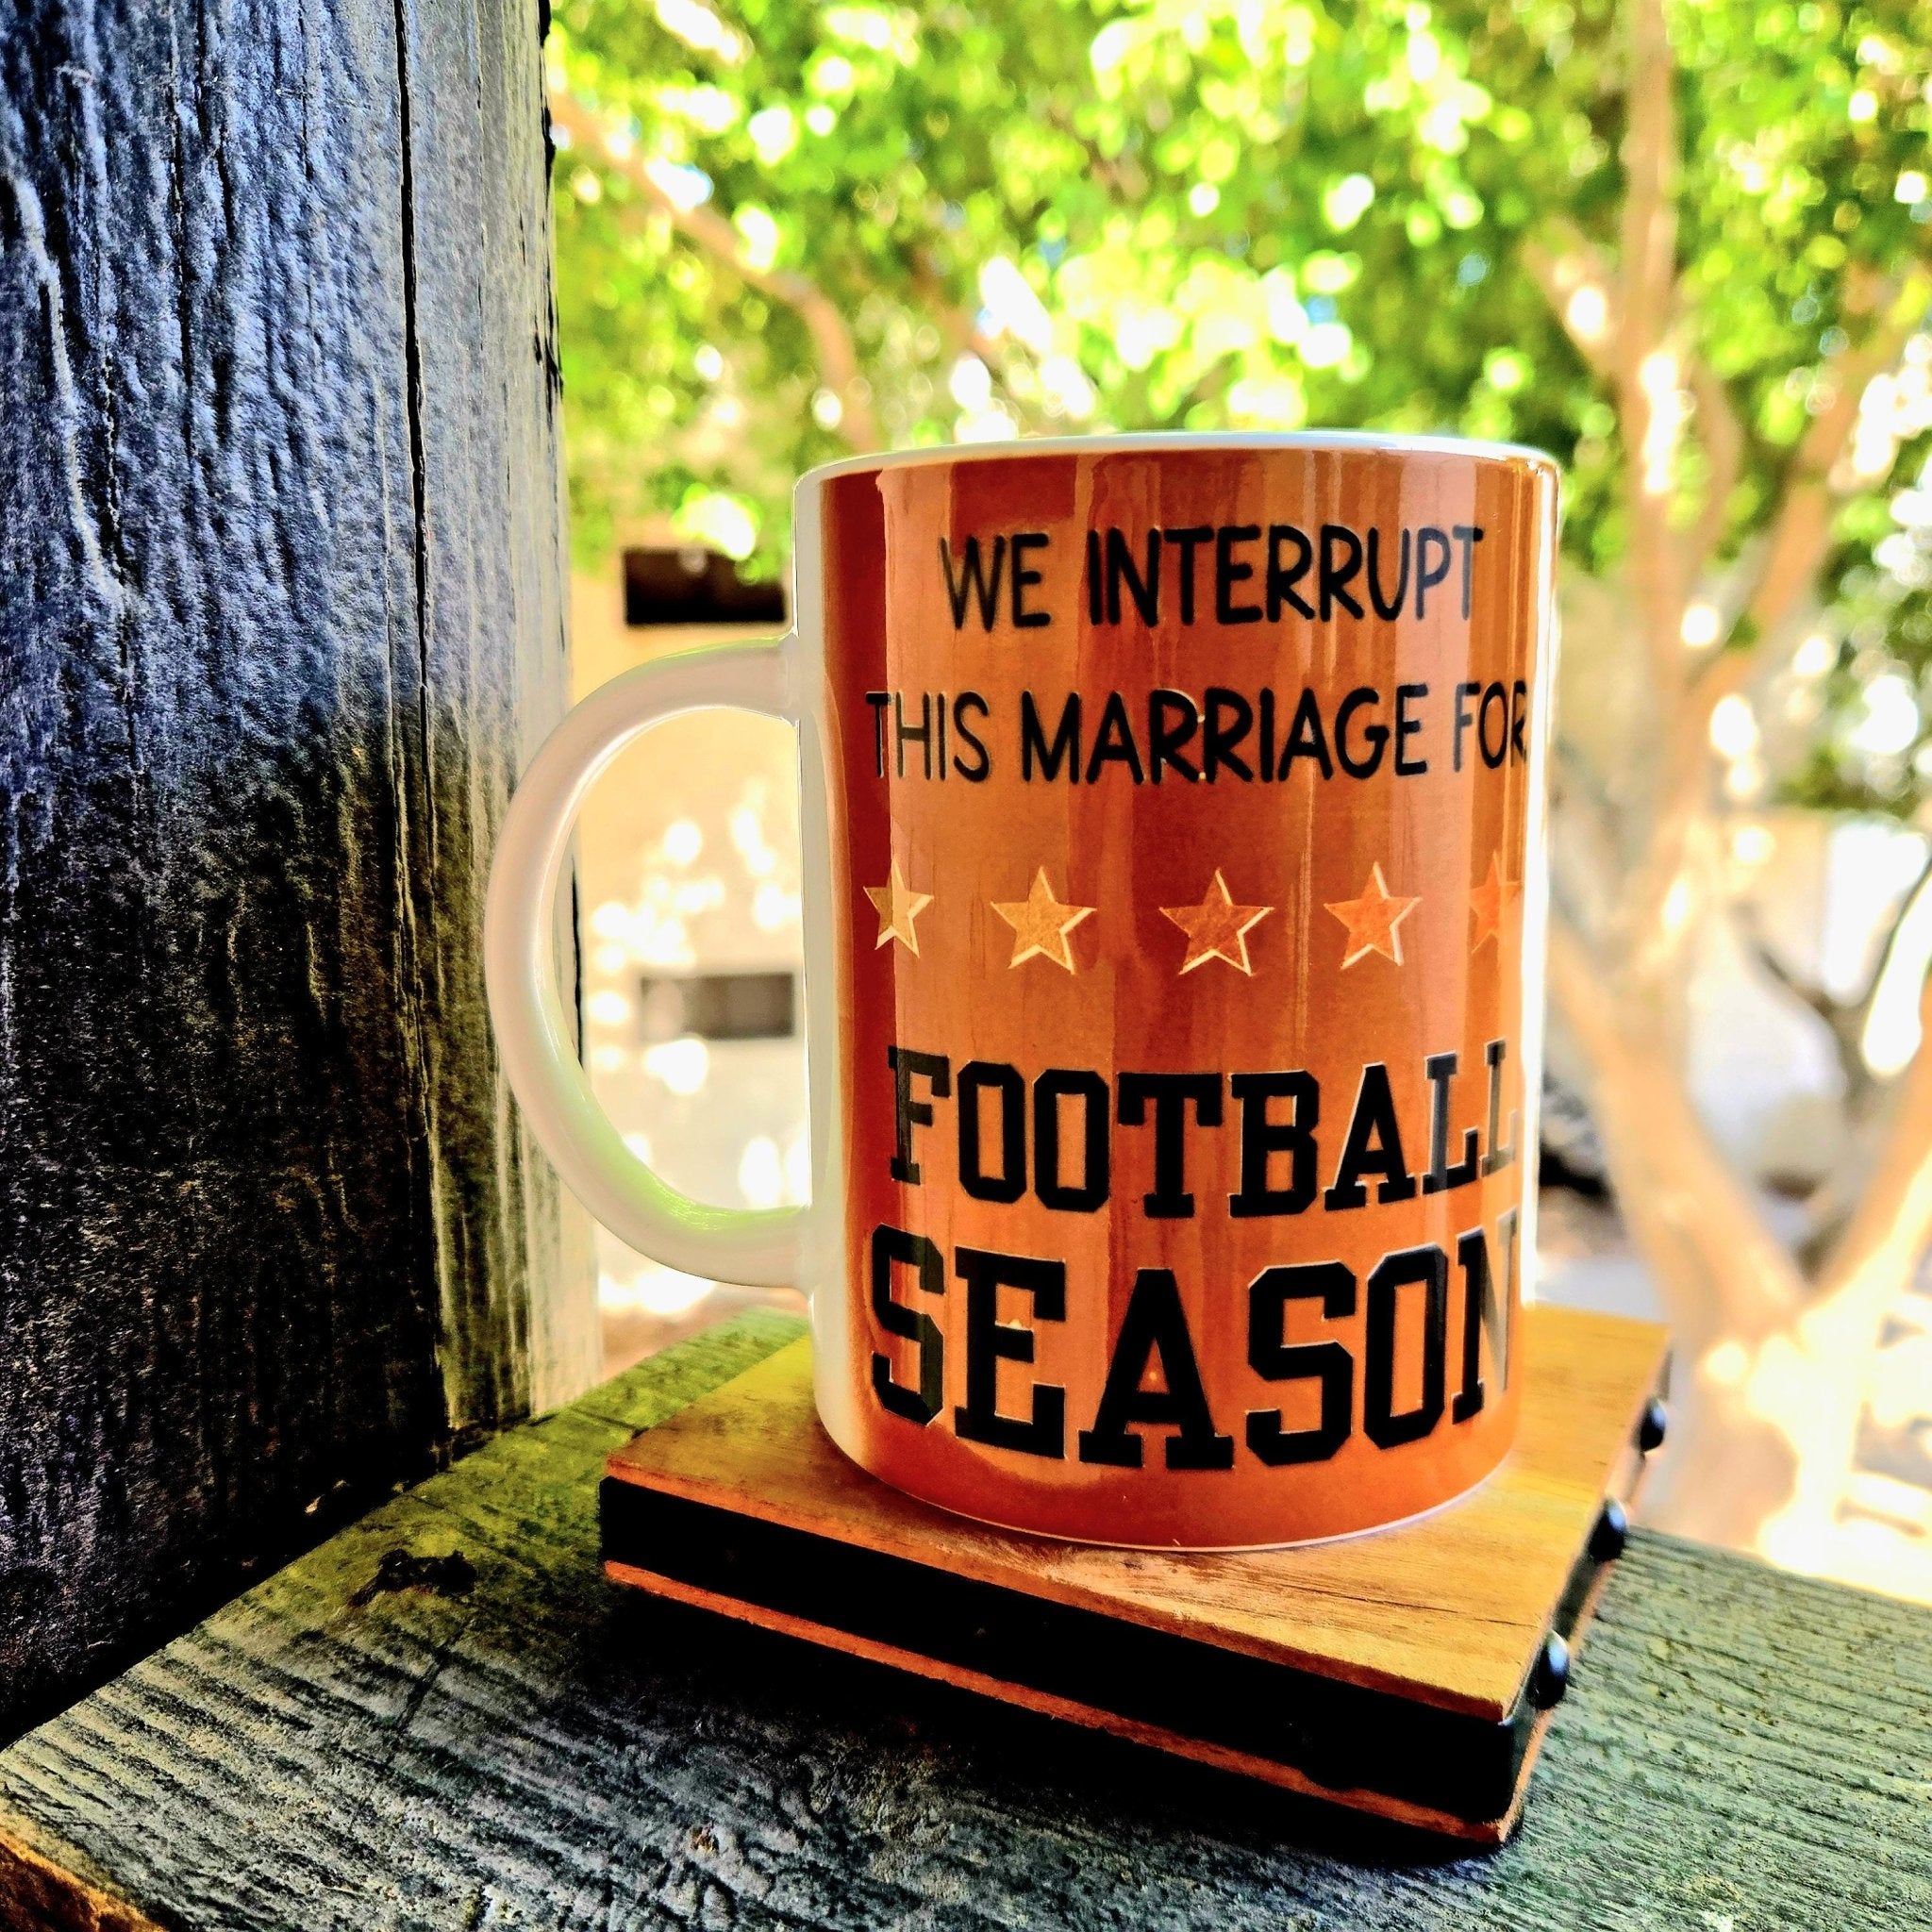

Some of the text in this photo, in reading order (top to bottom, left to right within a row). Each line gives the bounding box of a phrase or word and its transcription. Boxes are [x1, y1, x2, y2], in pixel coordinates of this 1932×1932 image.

[939, 525, 1484, 632] WE INTERRUPT
[866, 680, 1527, 785] THIS MARRIAGE FOR
[888, 1040, 1518, 1219] FOOTBALL
[872, 1207, 1517, 1470] SEASON
